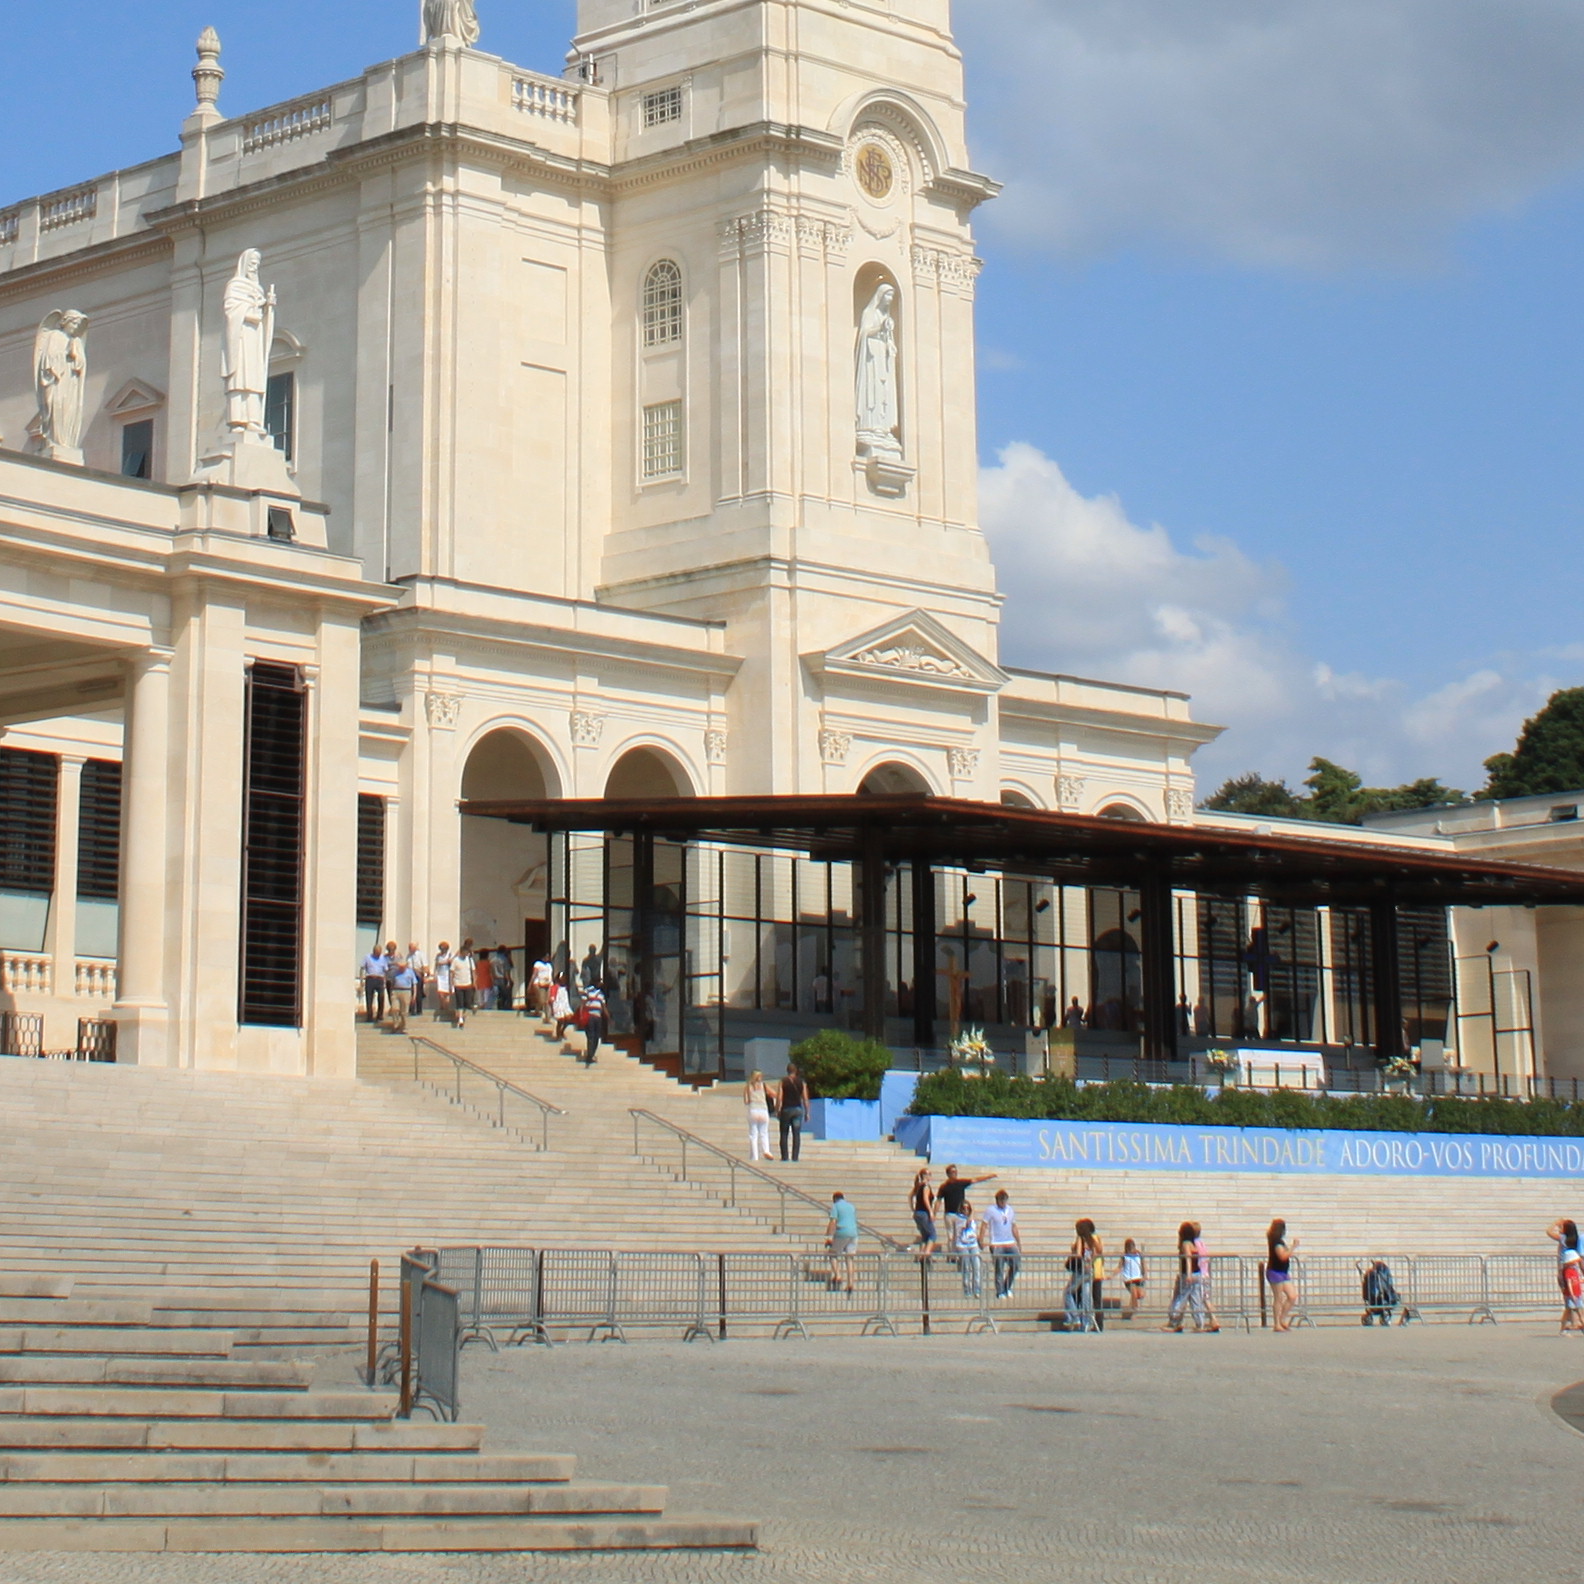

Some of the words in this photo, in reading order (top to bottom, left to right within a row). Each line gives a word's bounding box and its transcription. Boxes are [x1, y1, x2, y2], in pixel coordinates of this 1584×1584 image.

[1038, 1126, 1194, 1164] SANTÍSSIMA
[1199, 1134, 1327, 1167] TRINDADE
[1339, 1139, 1473, 1170] ADORO-VOS
